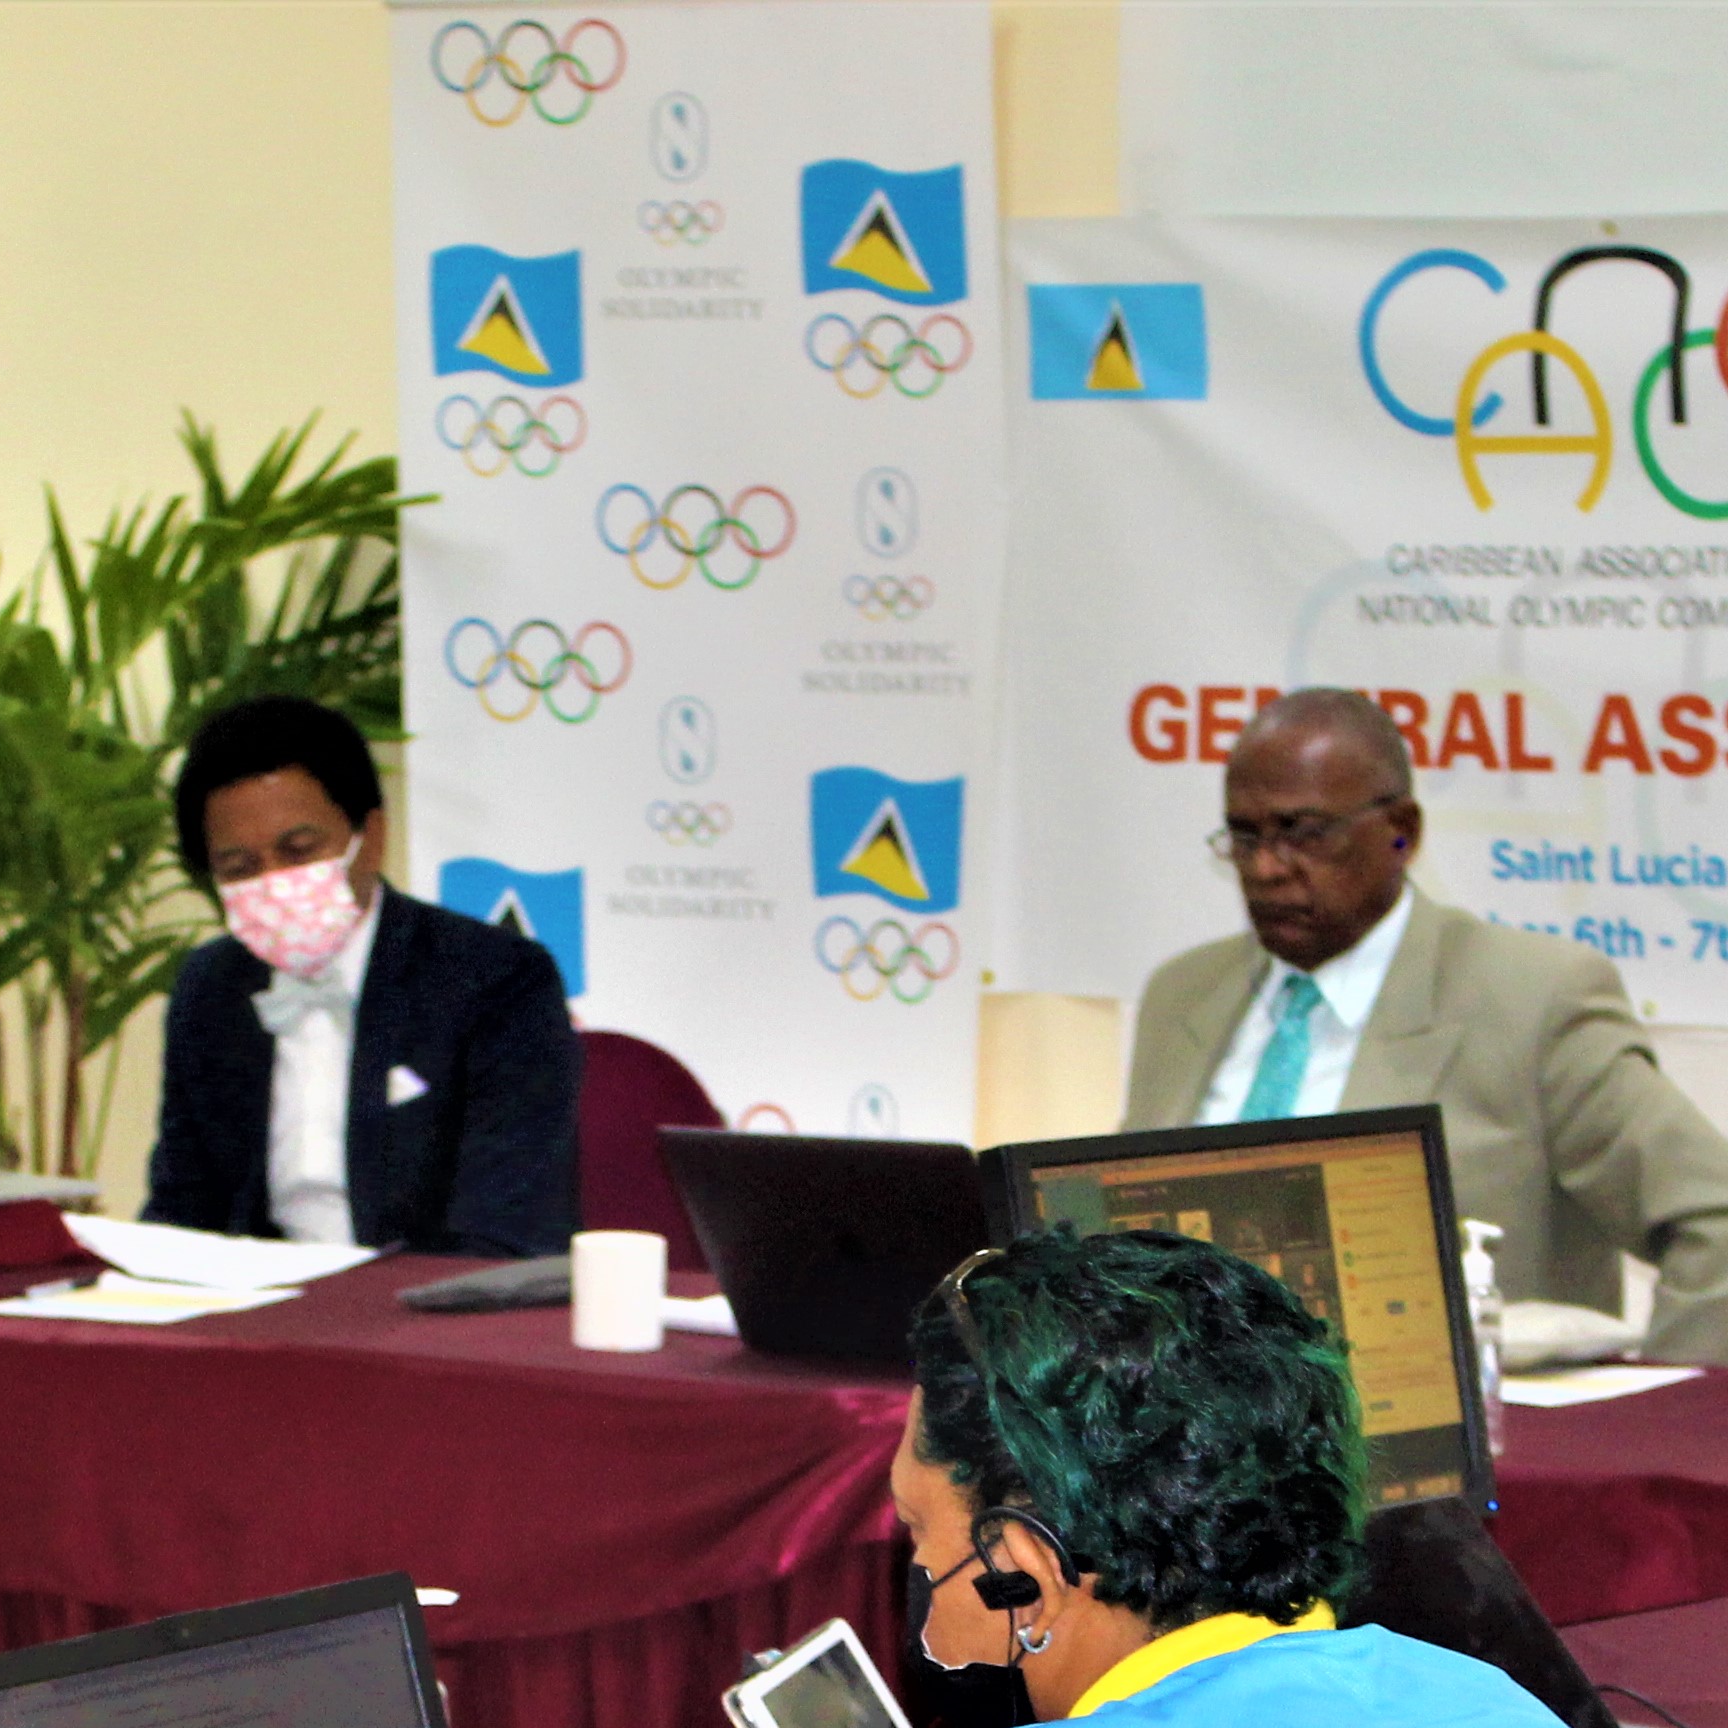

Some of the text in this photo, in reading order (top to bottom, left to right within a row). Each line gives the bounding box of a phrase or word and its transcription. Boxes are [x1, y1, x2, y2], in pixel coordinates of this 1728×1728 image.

[1386, 543, 1562, 577] CARIBBEAN
[1358, 594, 1499, 628] NATIONAL
[1508, 595, 1647, 629] OLYMPIC
[1128, 683, 1555, 773] GERAL
[1489, 838, 1728, 888] Saint Lucia
[1573, 914, 1646, 959] 6th
